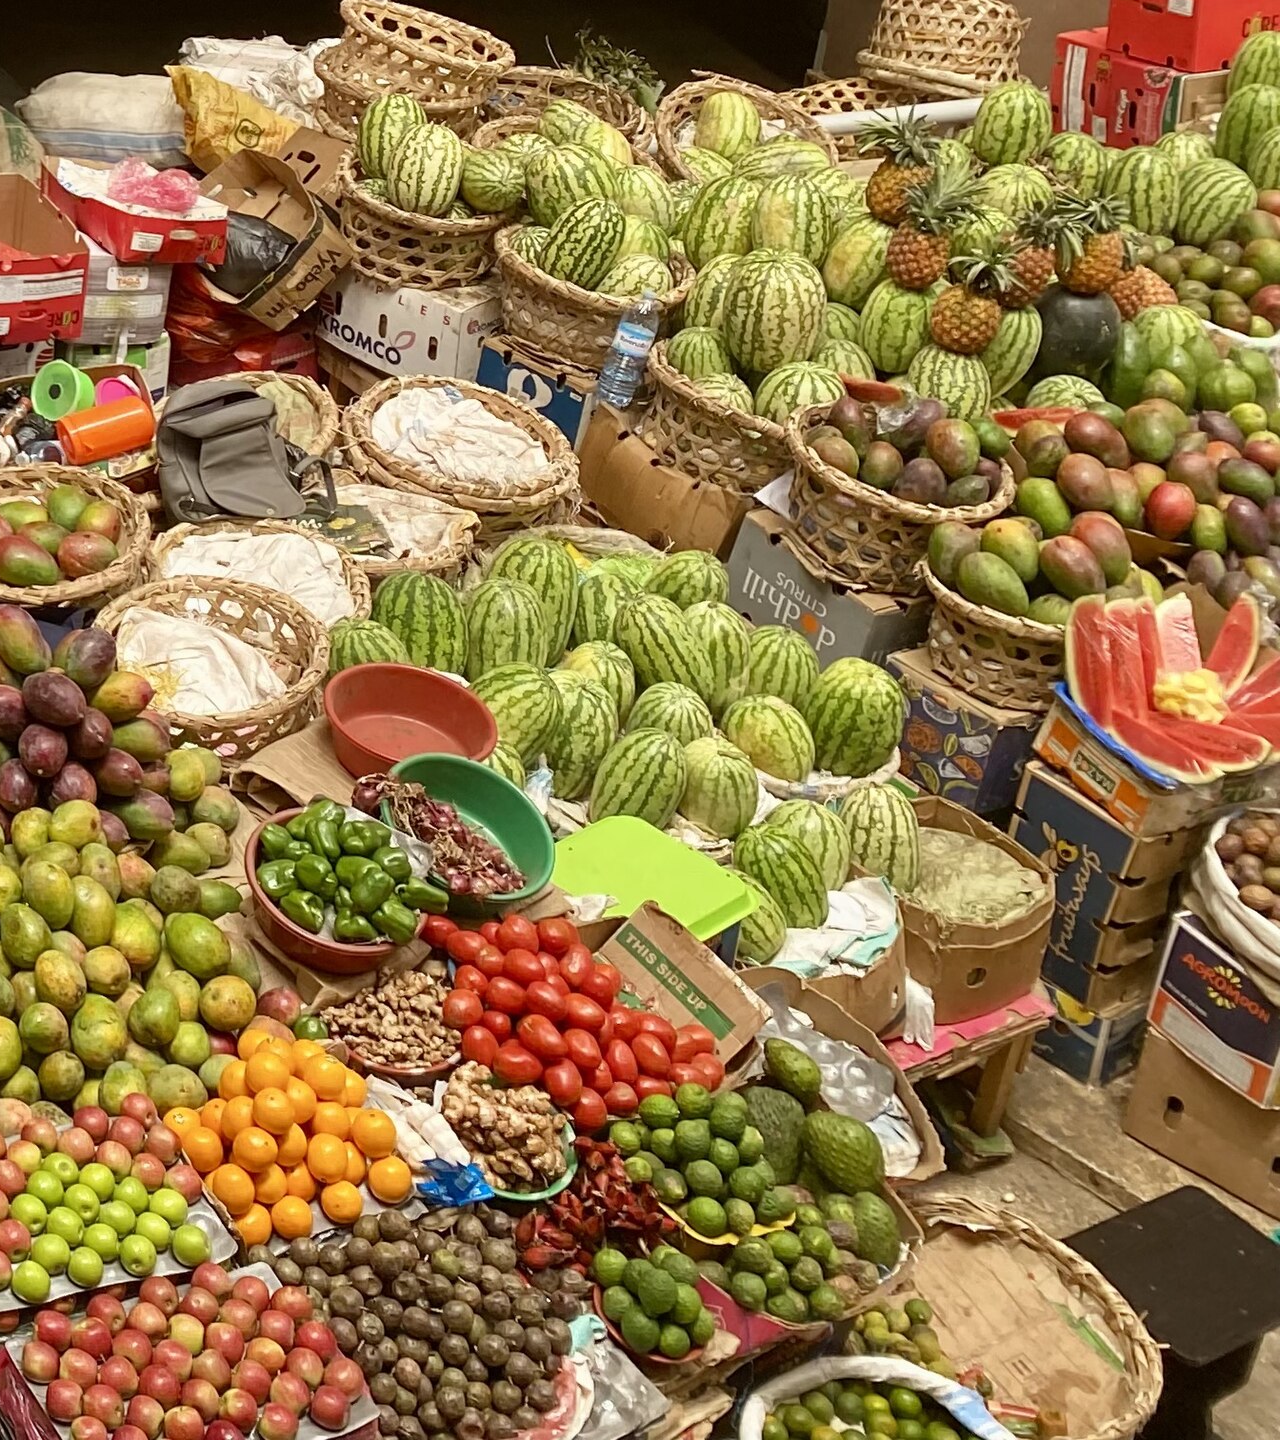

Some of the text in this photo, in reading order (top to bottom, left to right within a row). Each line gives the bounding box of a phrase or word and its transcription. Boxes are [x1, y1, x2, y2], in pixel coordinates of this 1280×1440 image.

[46, 309, 82, 328] CORE
[266, 247, 342, 319] Vyebom
[319, 310, 402, 366] KROMCO
[776, 571, 828, 618] CITRUS
[1048, 843, 1103, 963] fruitways
[625, 931, 707, 1012] THIS SIDE UP
[1181, 952, 1271, 1025] AGROMOON
